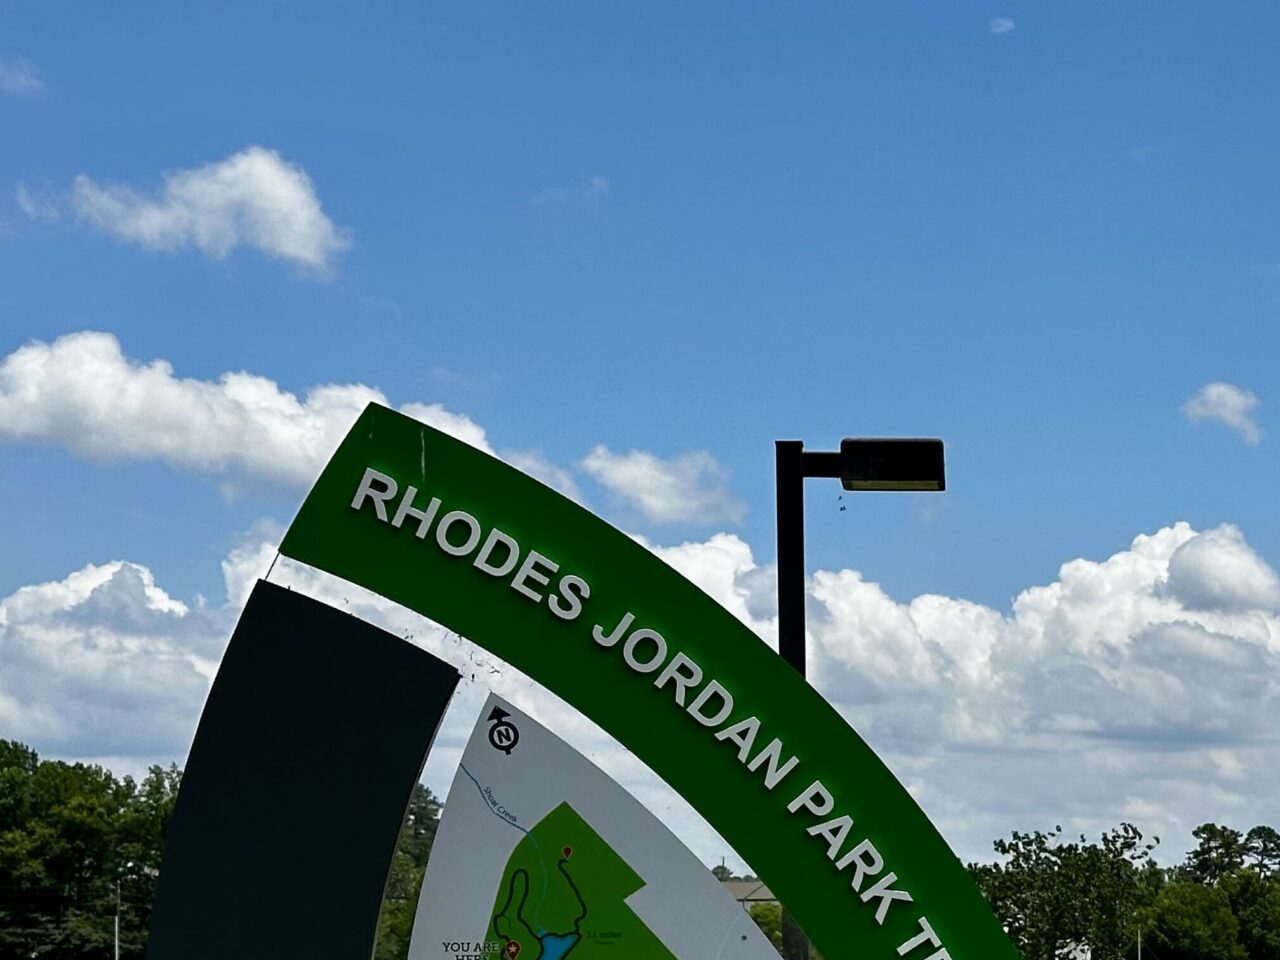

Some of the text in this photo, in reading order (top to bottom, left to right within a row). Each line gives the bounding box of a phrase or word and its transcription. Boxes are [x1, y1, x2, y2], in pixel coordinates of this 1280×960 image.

[350, 466, 591, 620] RHODES
[592, 611, 800, 790] JORDAN
[786, 780, 914, 926] PARK
[442, 942, 500, 952] YOU ARE
